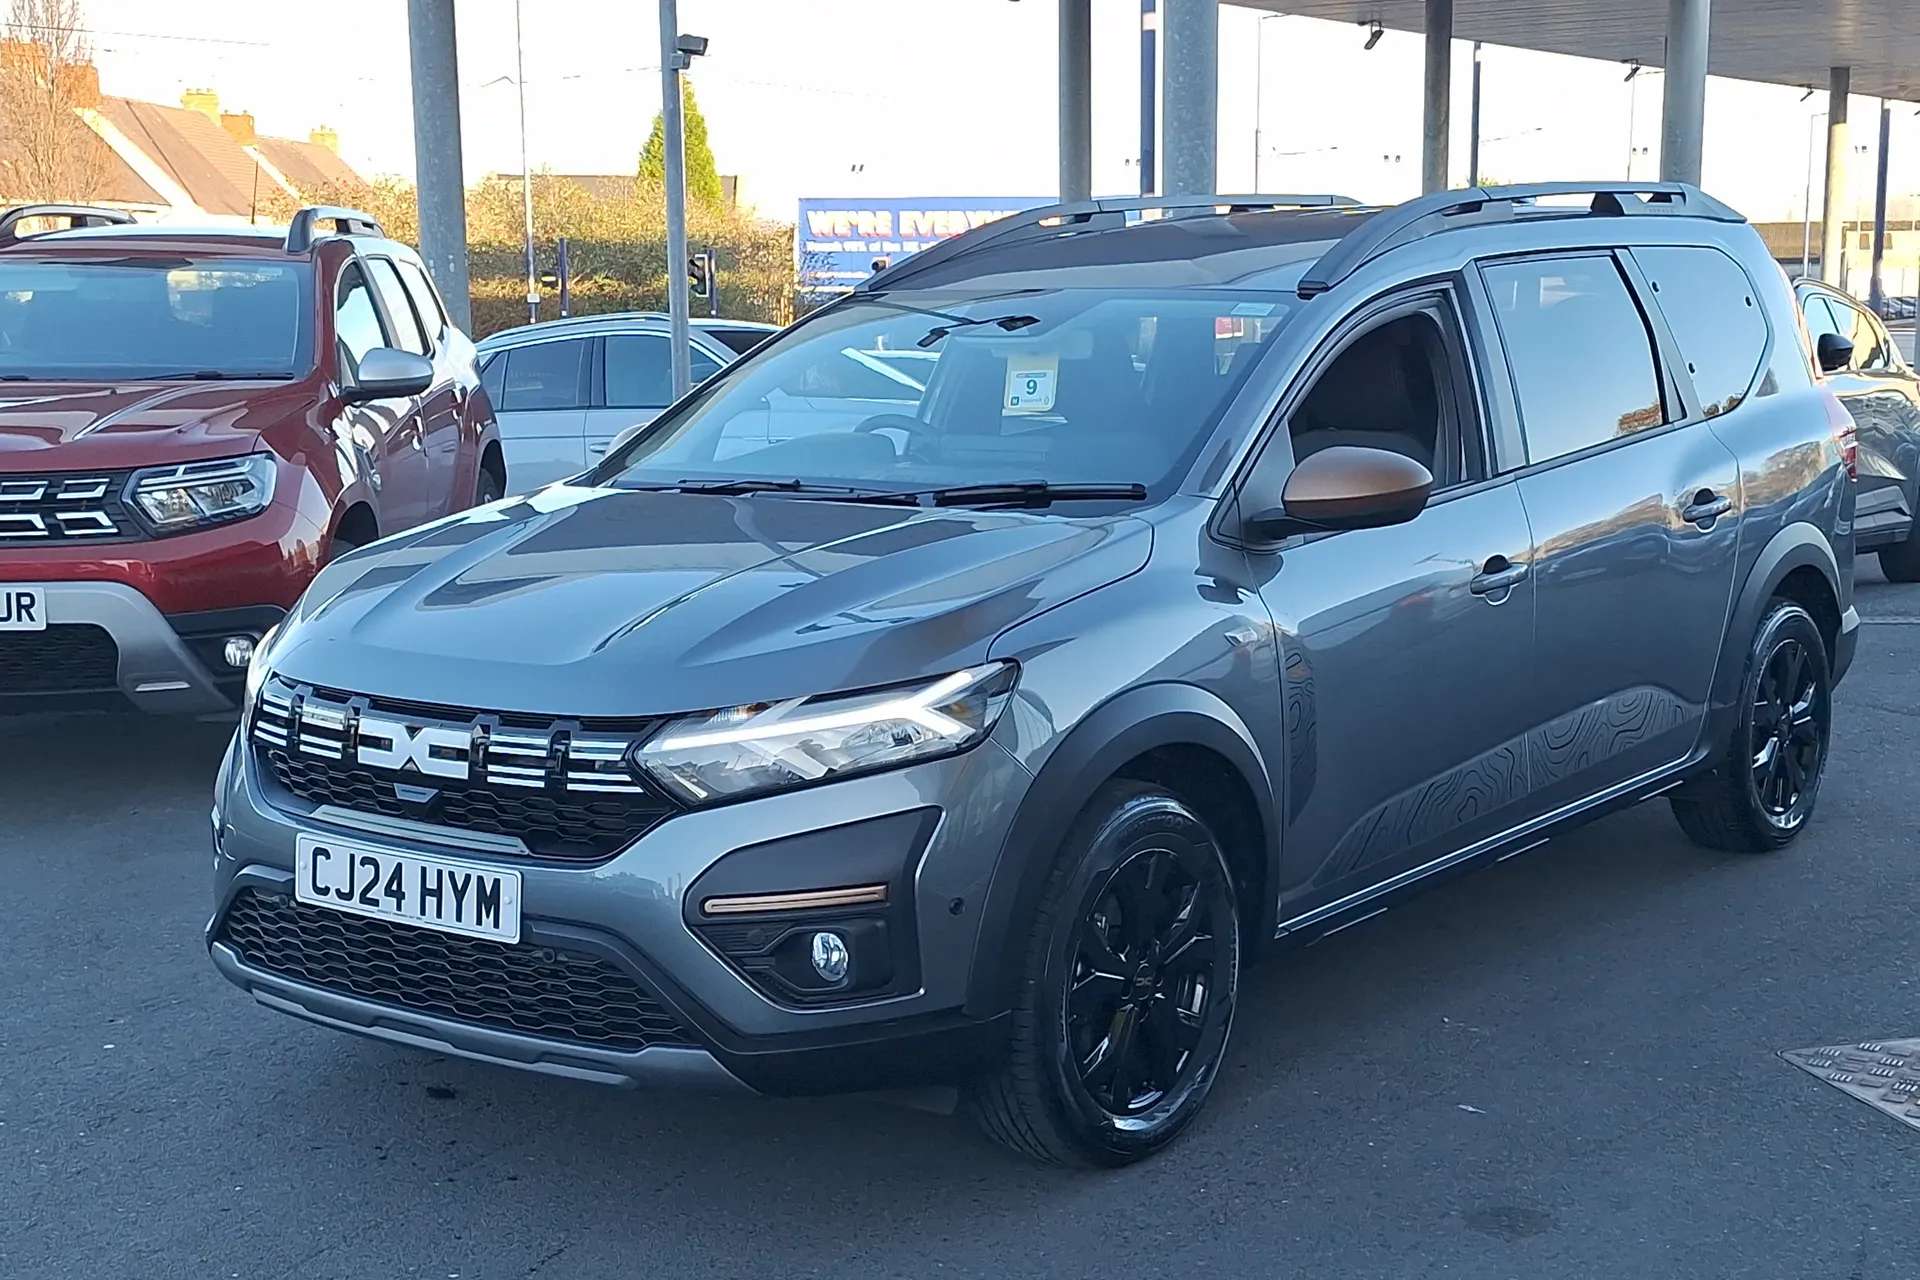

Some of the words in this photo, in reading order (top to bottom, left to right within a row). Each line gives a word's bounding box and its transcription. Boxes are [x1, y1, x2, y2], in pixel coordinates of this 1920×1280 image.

[1026, 379, 1038, 396] 9
[311, 846, 406, 913] CJ24
[419, 865, 501, 930] HYM
